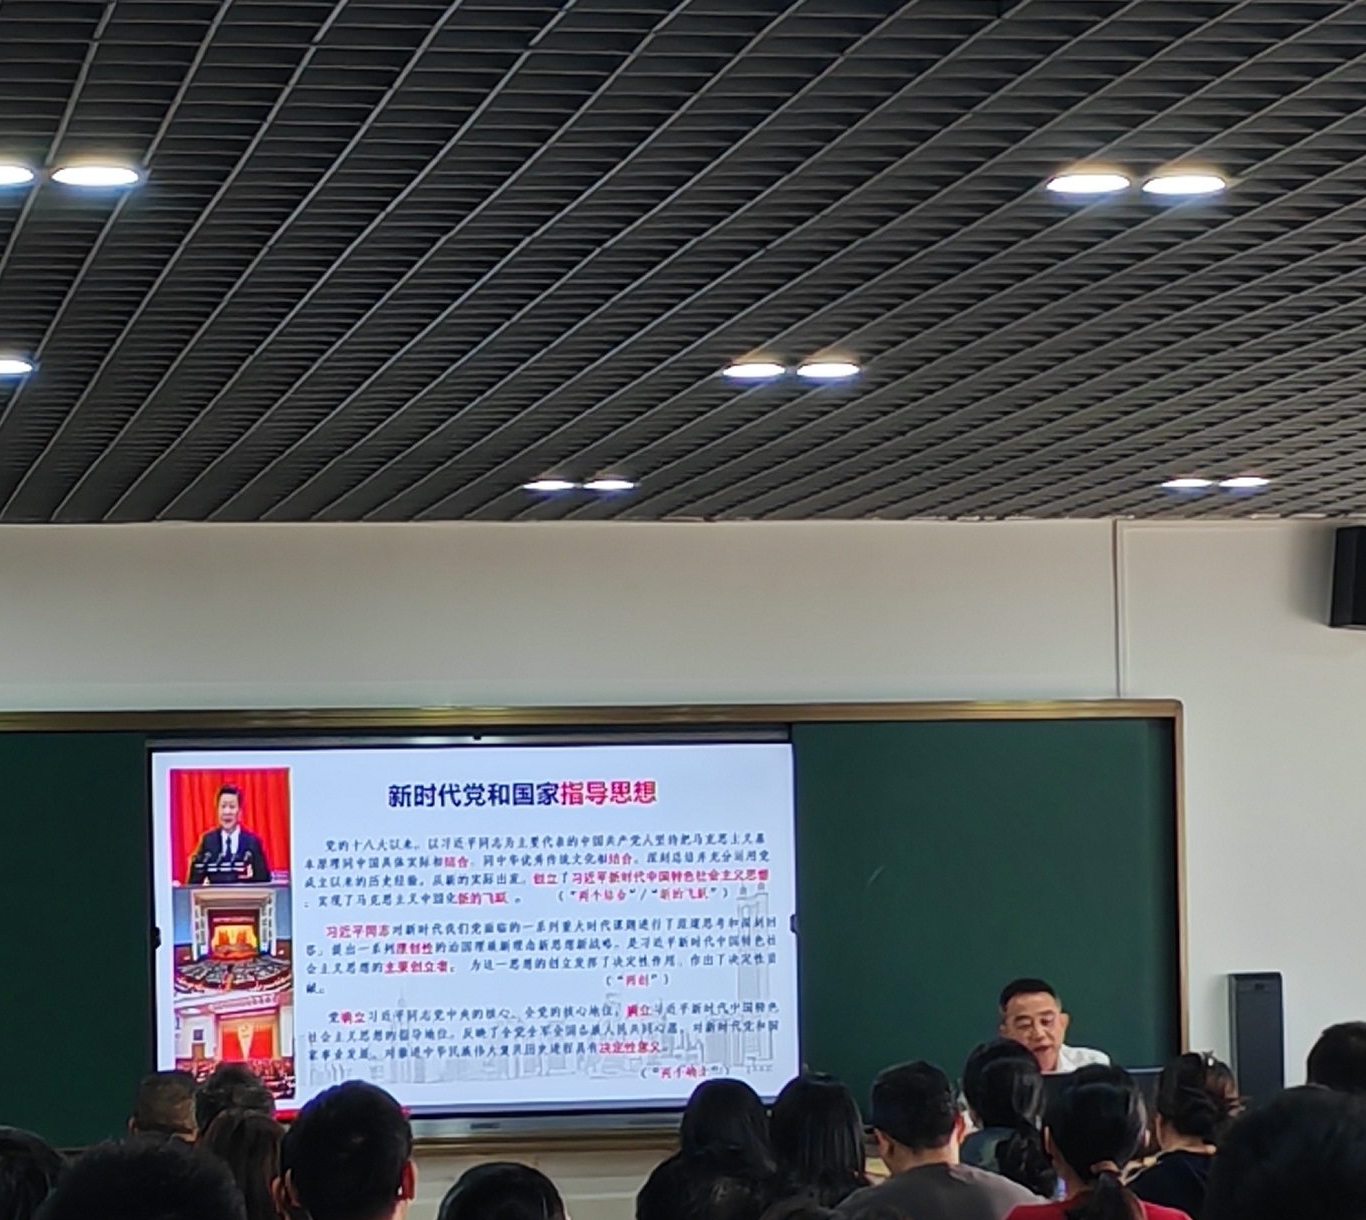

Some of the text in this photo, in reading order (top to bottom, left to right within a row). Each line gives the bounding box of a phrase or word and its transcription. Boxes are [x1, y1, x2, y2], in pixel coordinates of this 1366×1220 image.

[388, 779, 658, 808] 新时代党和国家指导思想
